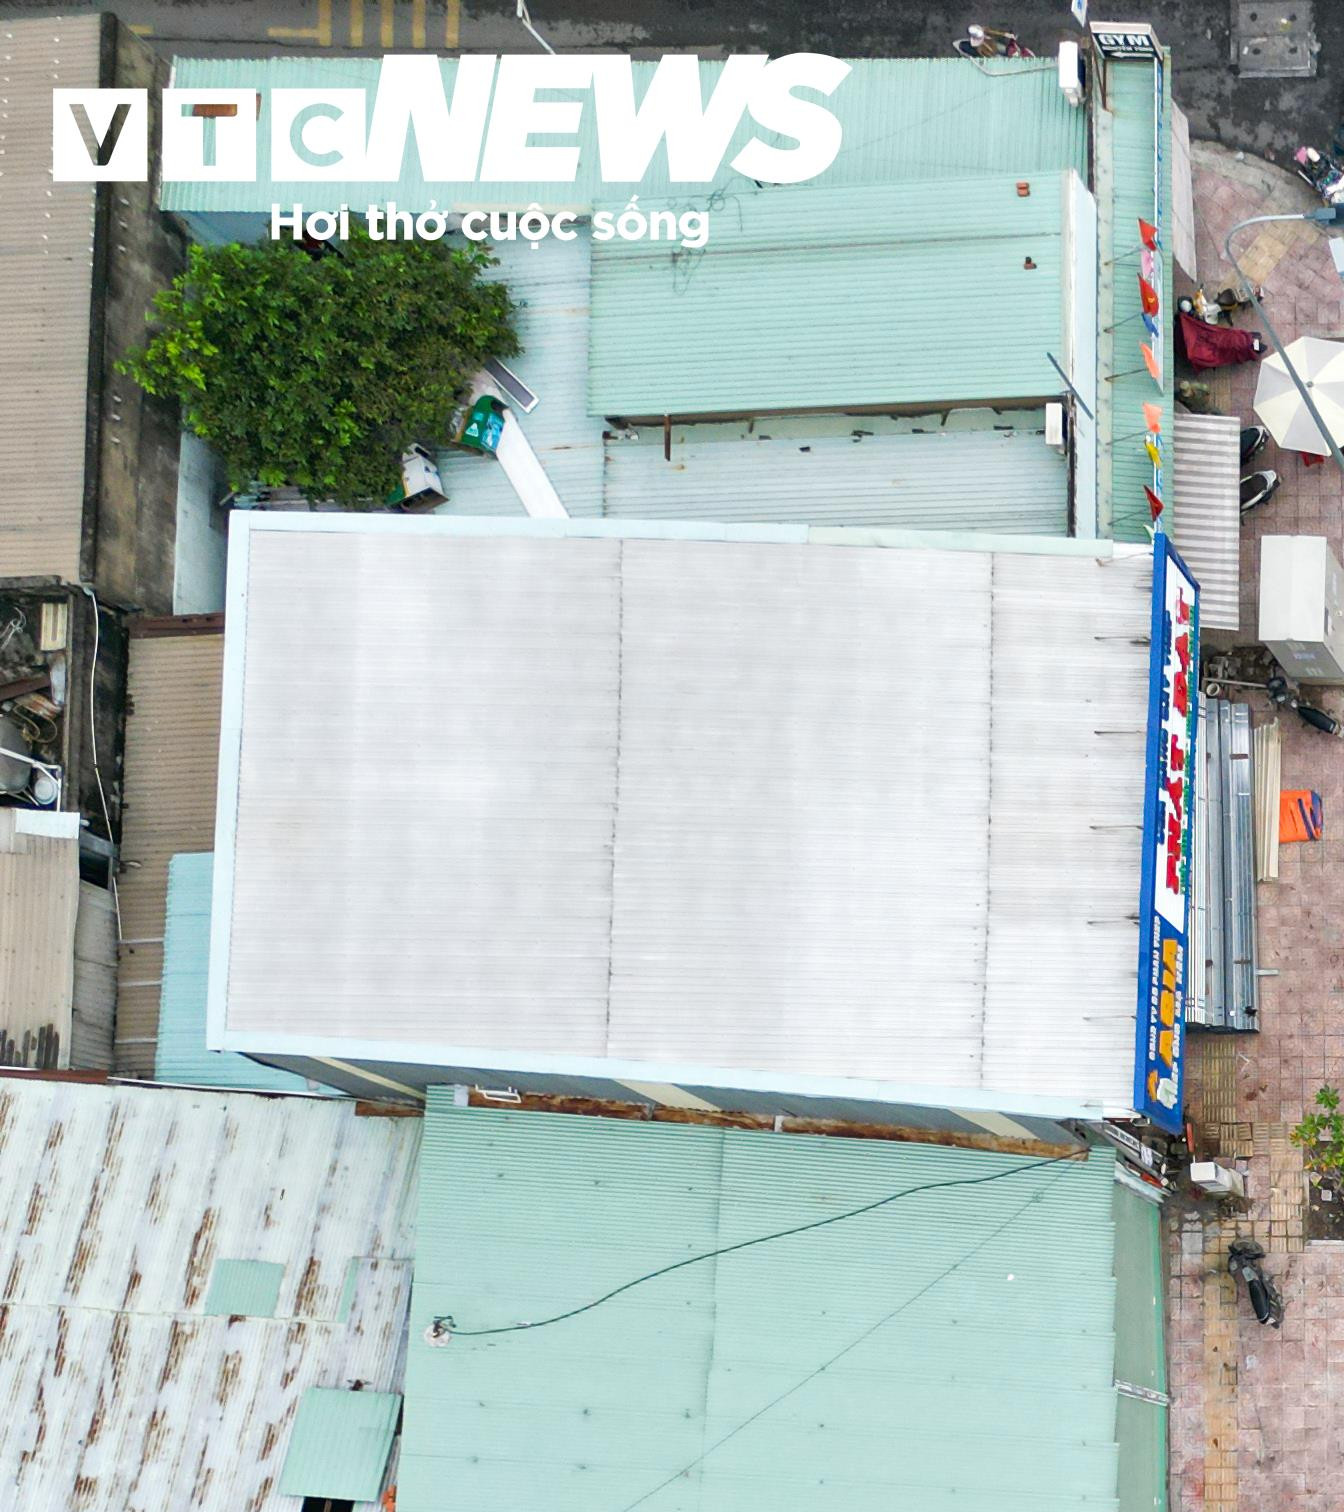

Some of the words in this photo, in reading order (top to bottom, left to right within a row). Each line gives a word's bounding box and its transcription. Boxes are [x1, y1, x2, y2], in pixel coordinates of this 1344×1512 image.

[1098, 34, 1150, 46] GYM
[1165, 734, 1184, 894] PHÁT
[1159, 939, 1177, 1069] ASIA
